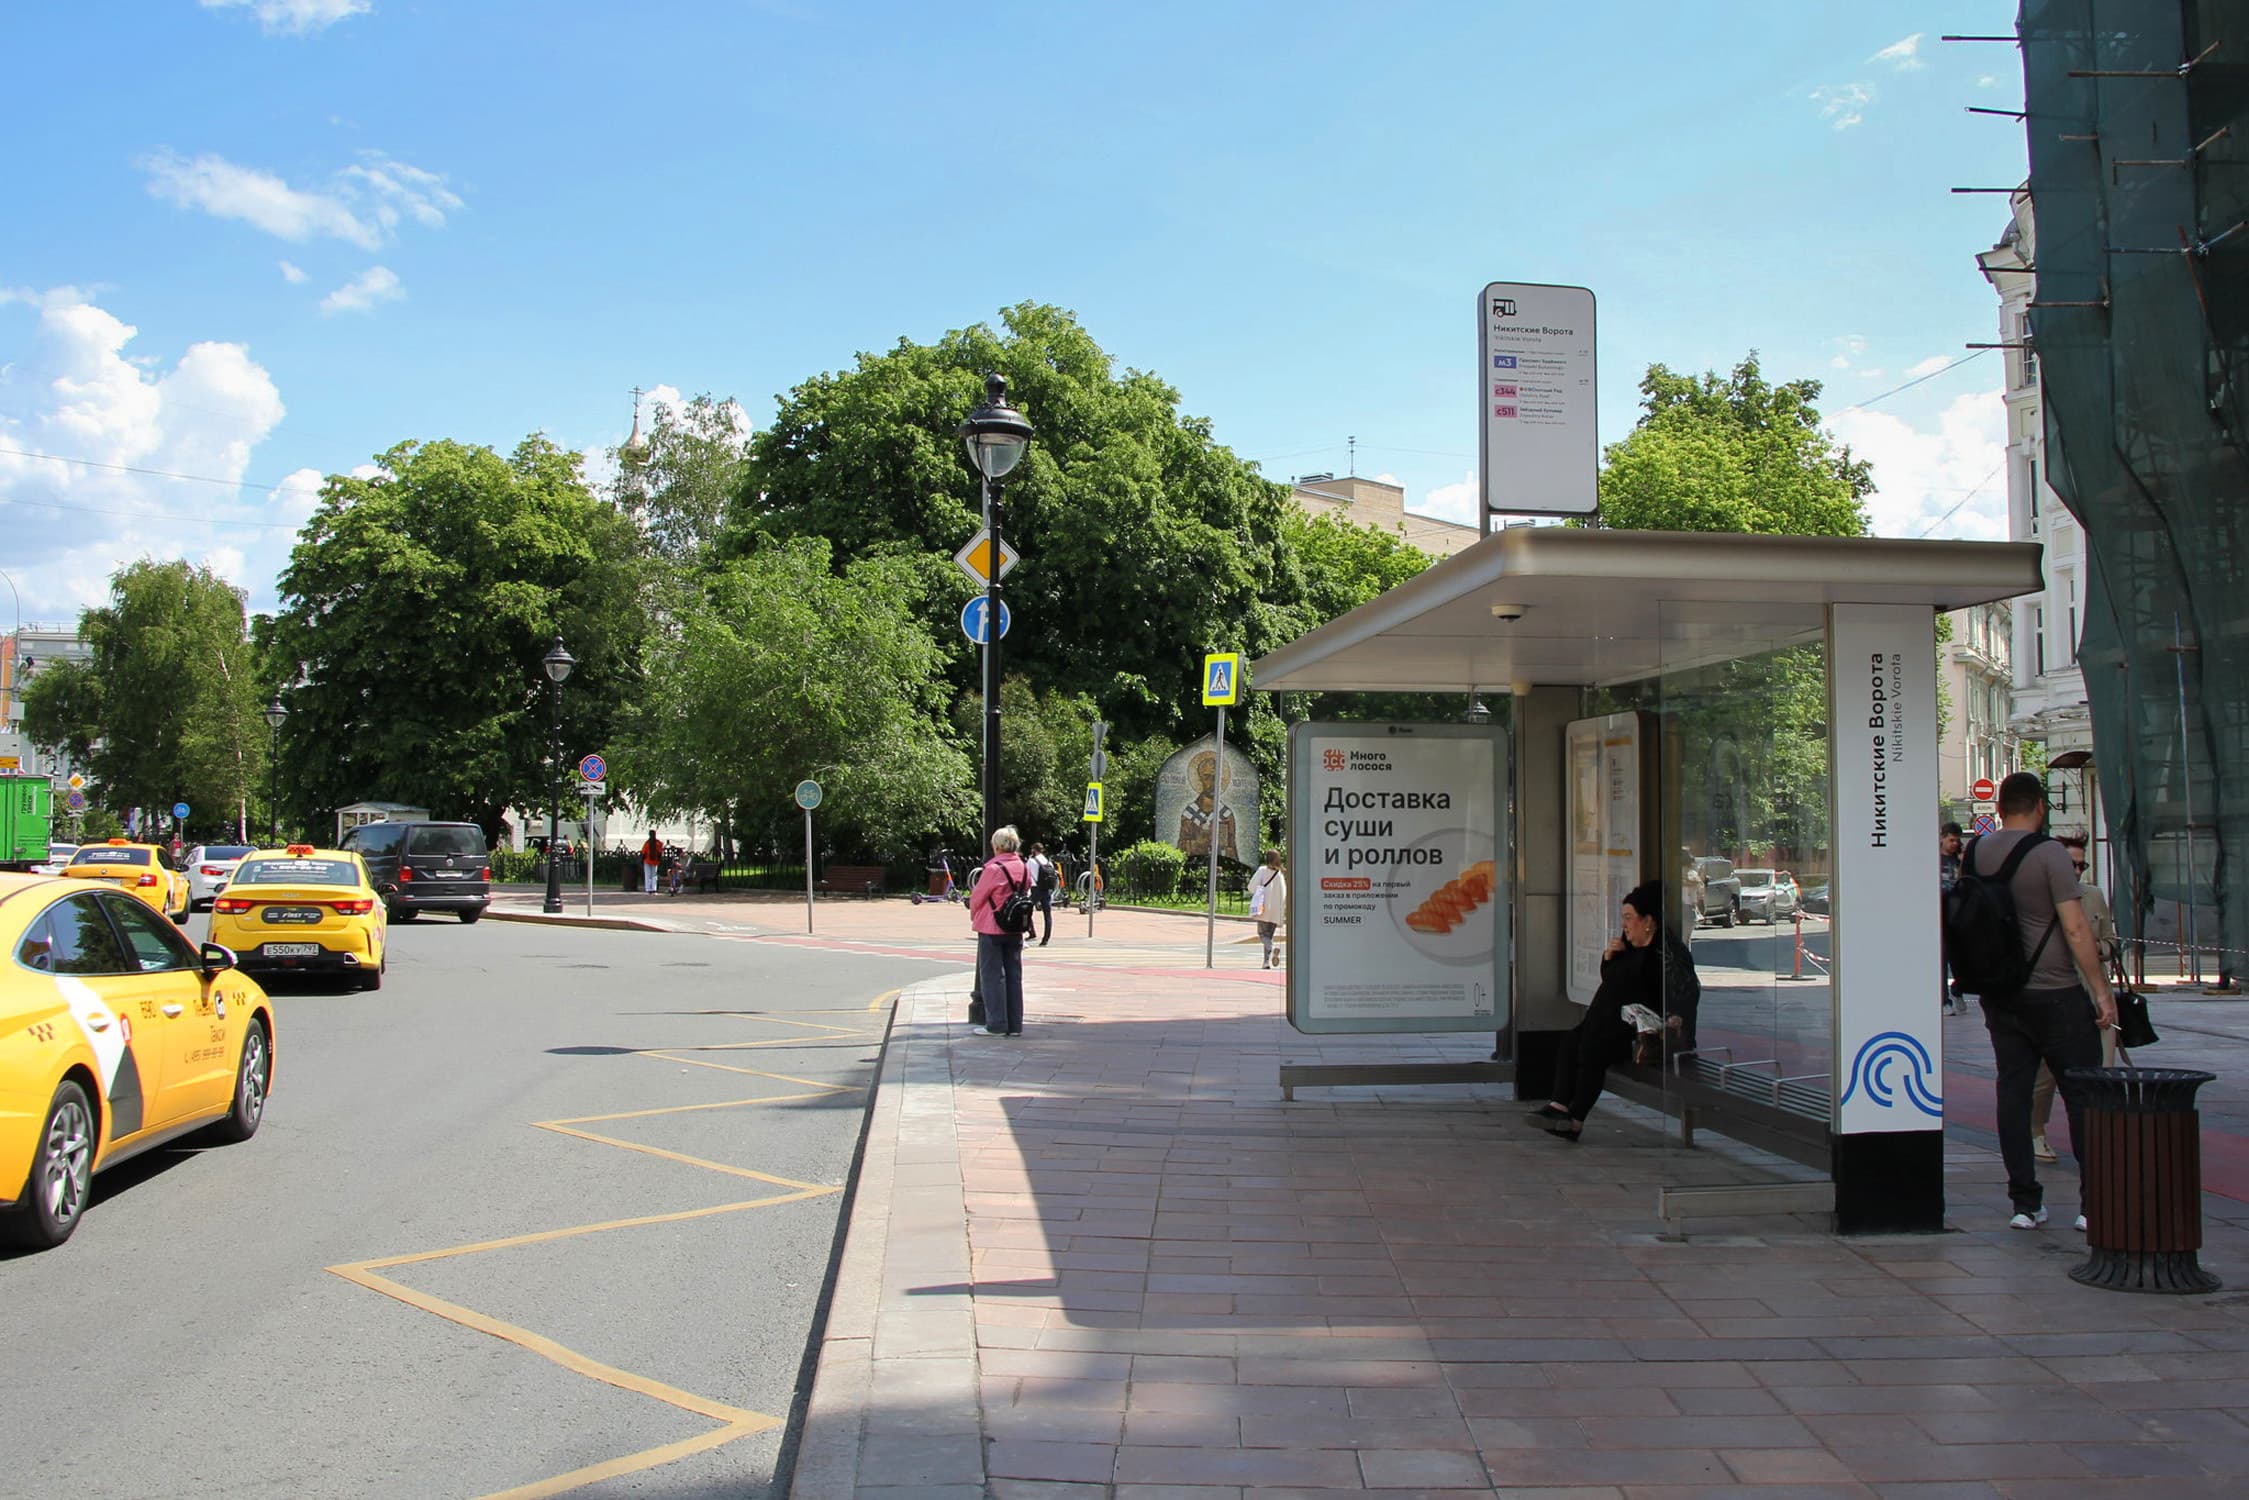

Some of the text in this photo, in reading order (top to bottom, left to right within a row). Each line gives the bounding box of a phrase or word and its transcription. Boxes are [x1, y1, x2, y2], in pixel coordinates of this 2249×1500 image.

[1493, 324, 1574, 336] Никитские Ворота
[1891, 654, 1904, 762] Nikitskie Vorota
[1350, 750, 1387, 761] Много
[1869, 653, 1887, 847] Никитские Ворота
[1350, 763, 1392, 771] лосося
[1324, 787, 1450, 813] Доставка
[1325, 820, 1393, 842] суши
[1325, 848, 1443, 870] и роллов
[1382, 880, 1411, 889] первый
[1352, 892, 1399, 900] приложении
[1334, 903, 1377, 911] промокоду
[1323, 915, 1362, 924] SUMMER
